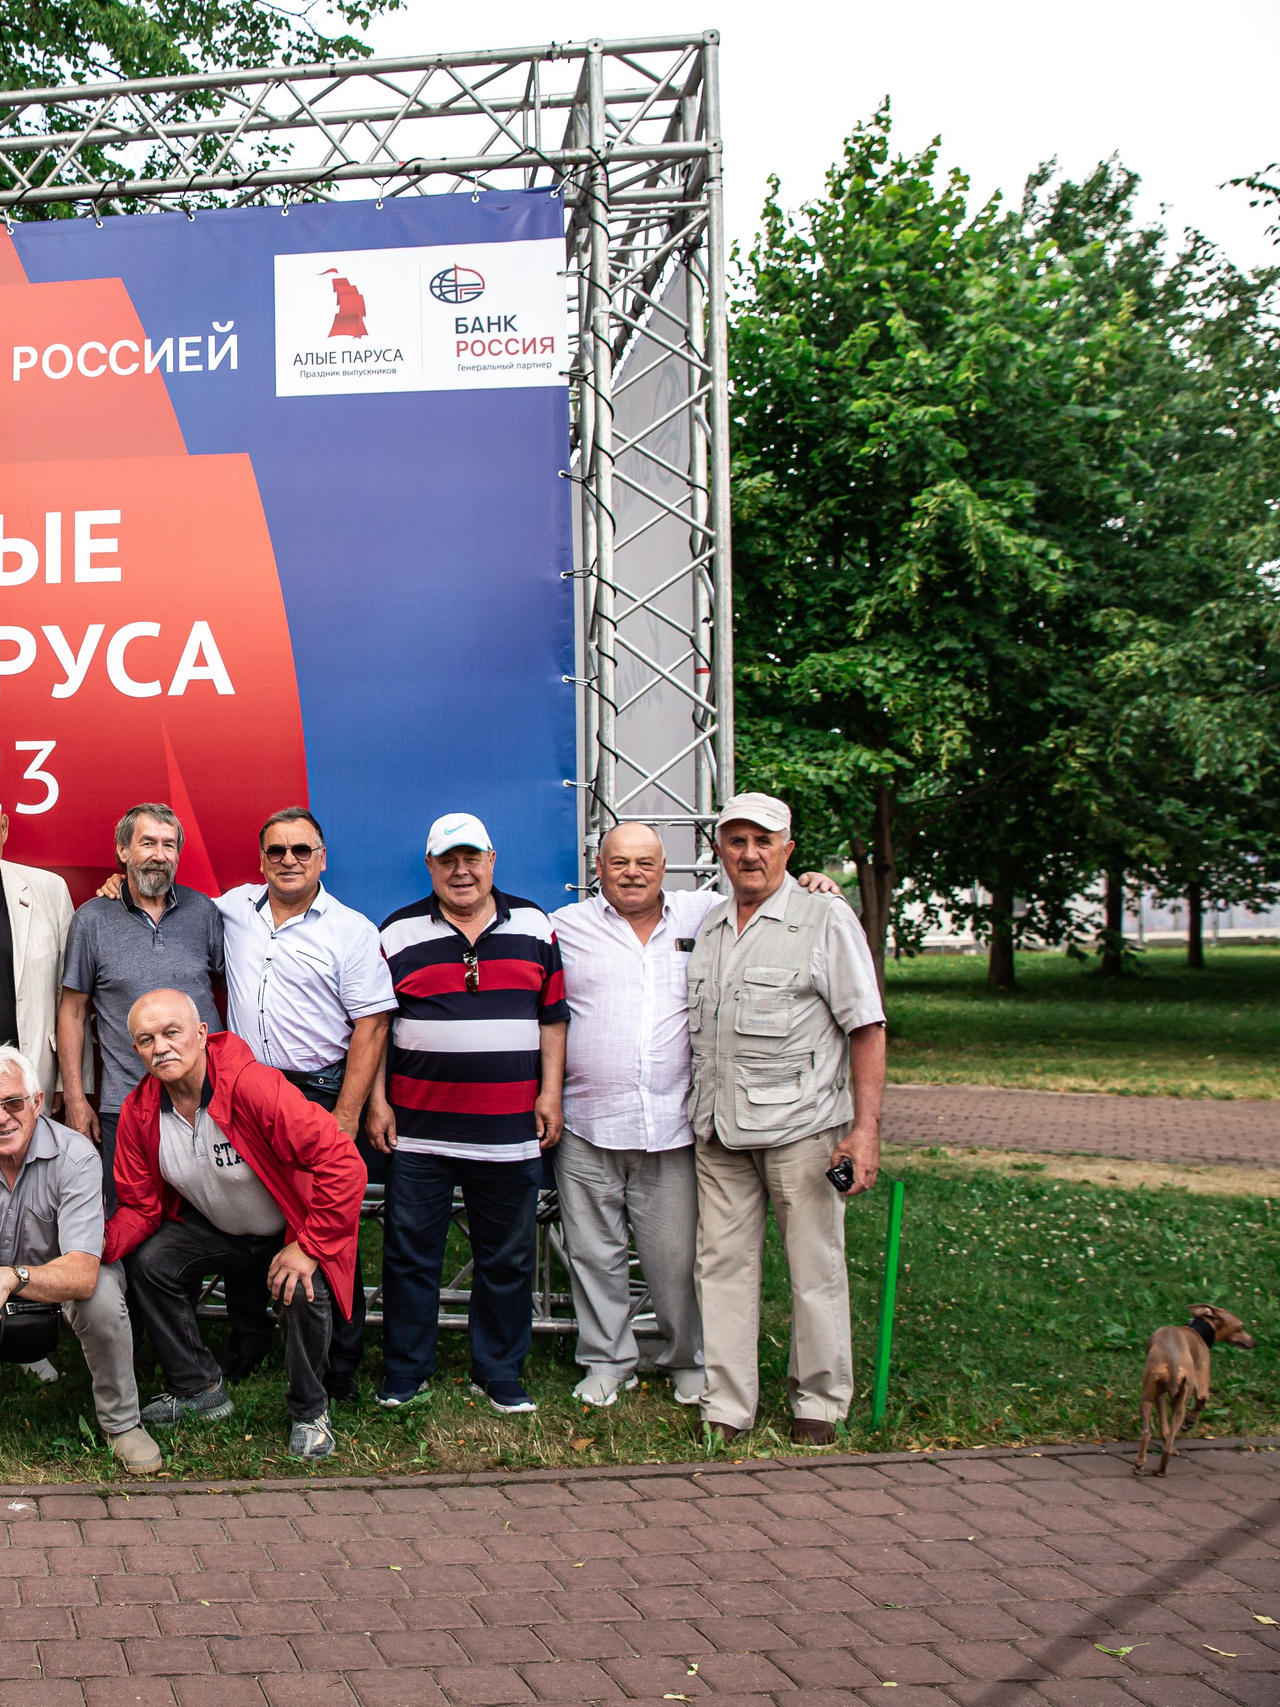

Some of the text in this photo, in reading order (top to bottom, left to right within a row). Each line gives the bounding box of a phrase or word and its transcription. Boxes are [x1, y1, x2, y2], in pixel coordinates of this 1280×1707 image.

[455, 314, 518, 335] БАНК
[13, 320, 238, 381] РОССИЕЙ
[456, 336, 555, 358] РОССИЯ
[293, 348, 404, 366] АЛЫЕ ПАРУСА
[299, 367, 397, 379] Праздник выпускников
[457, 361, 553, 373] Генеральный партнер
